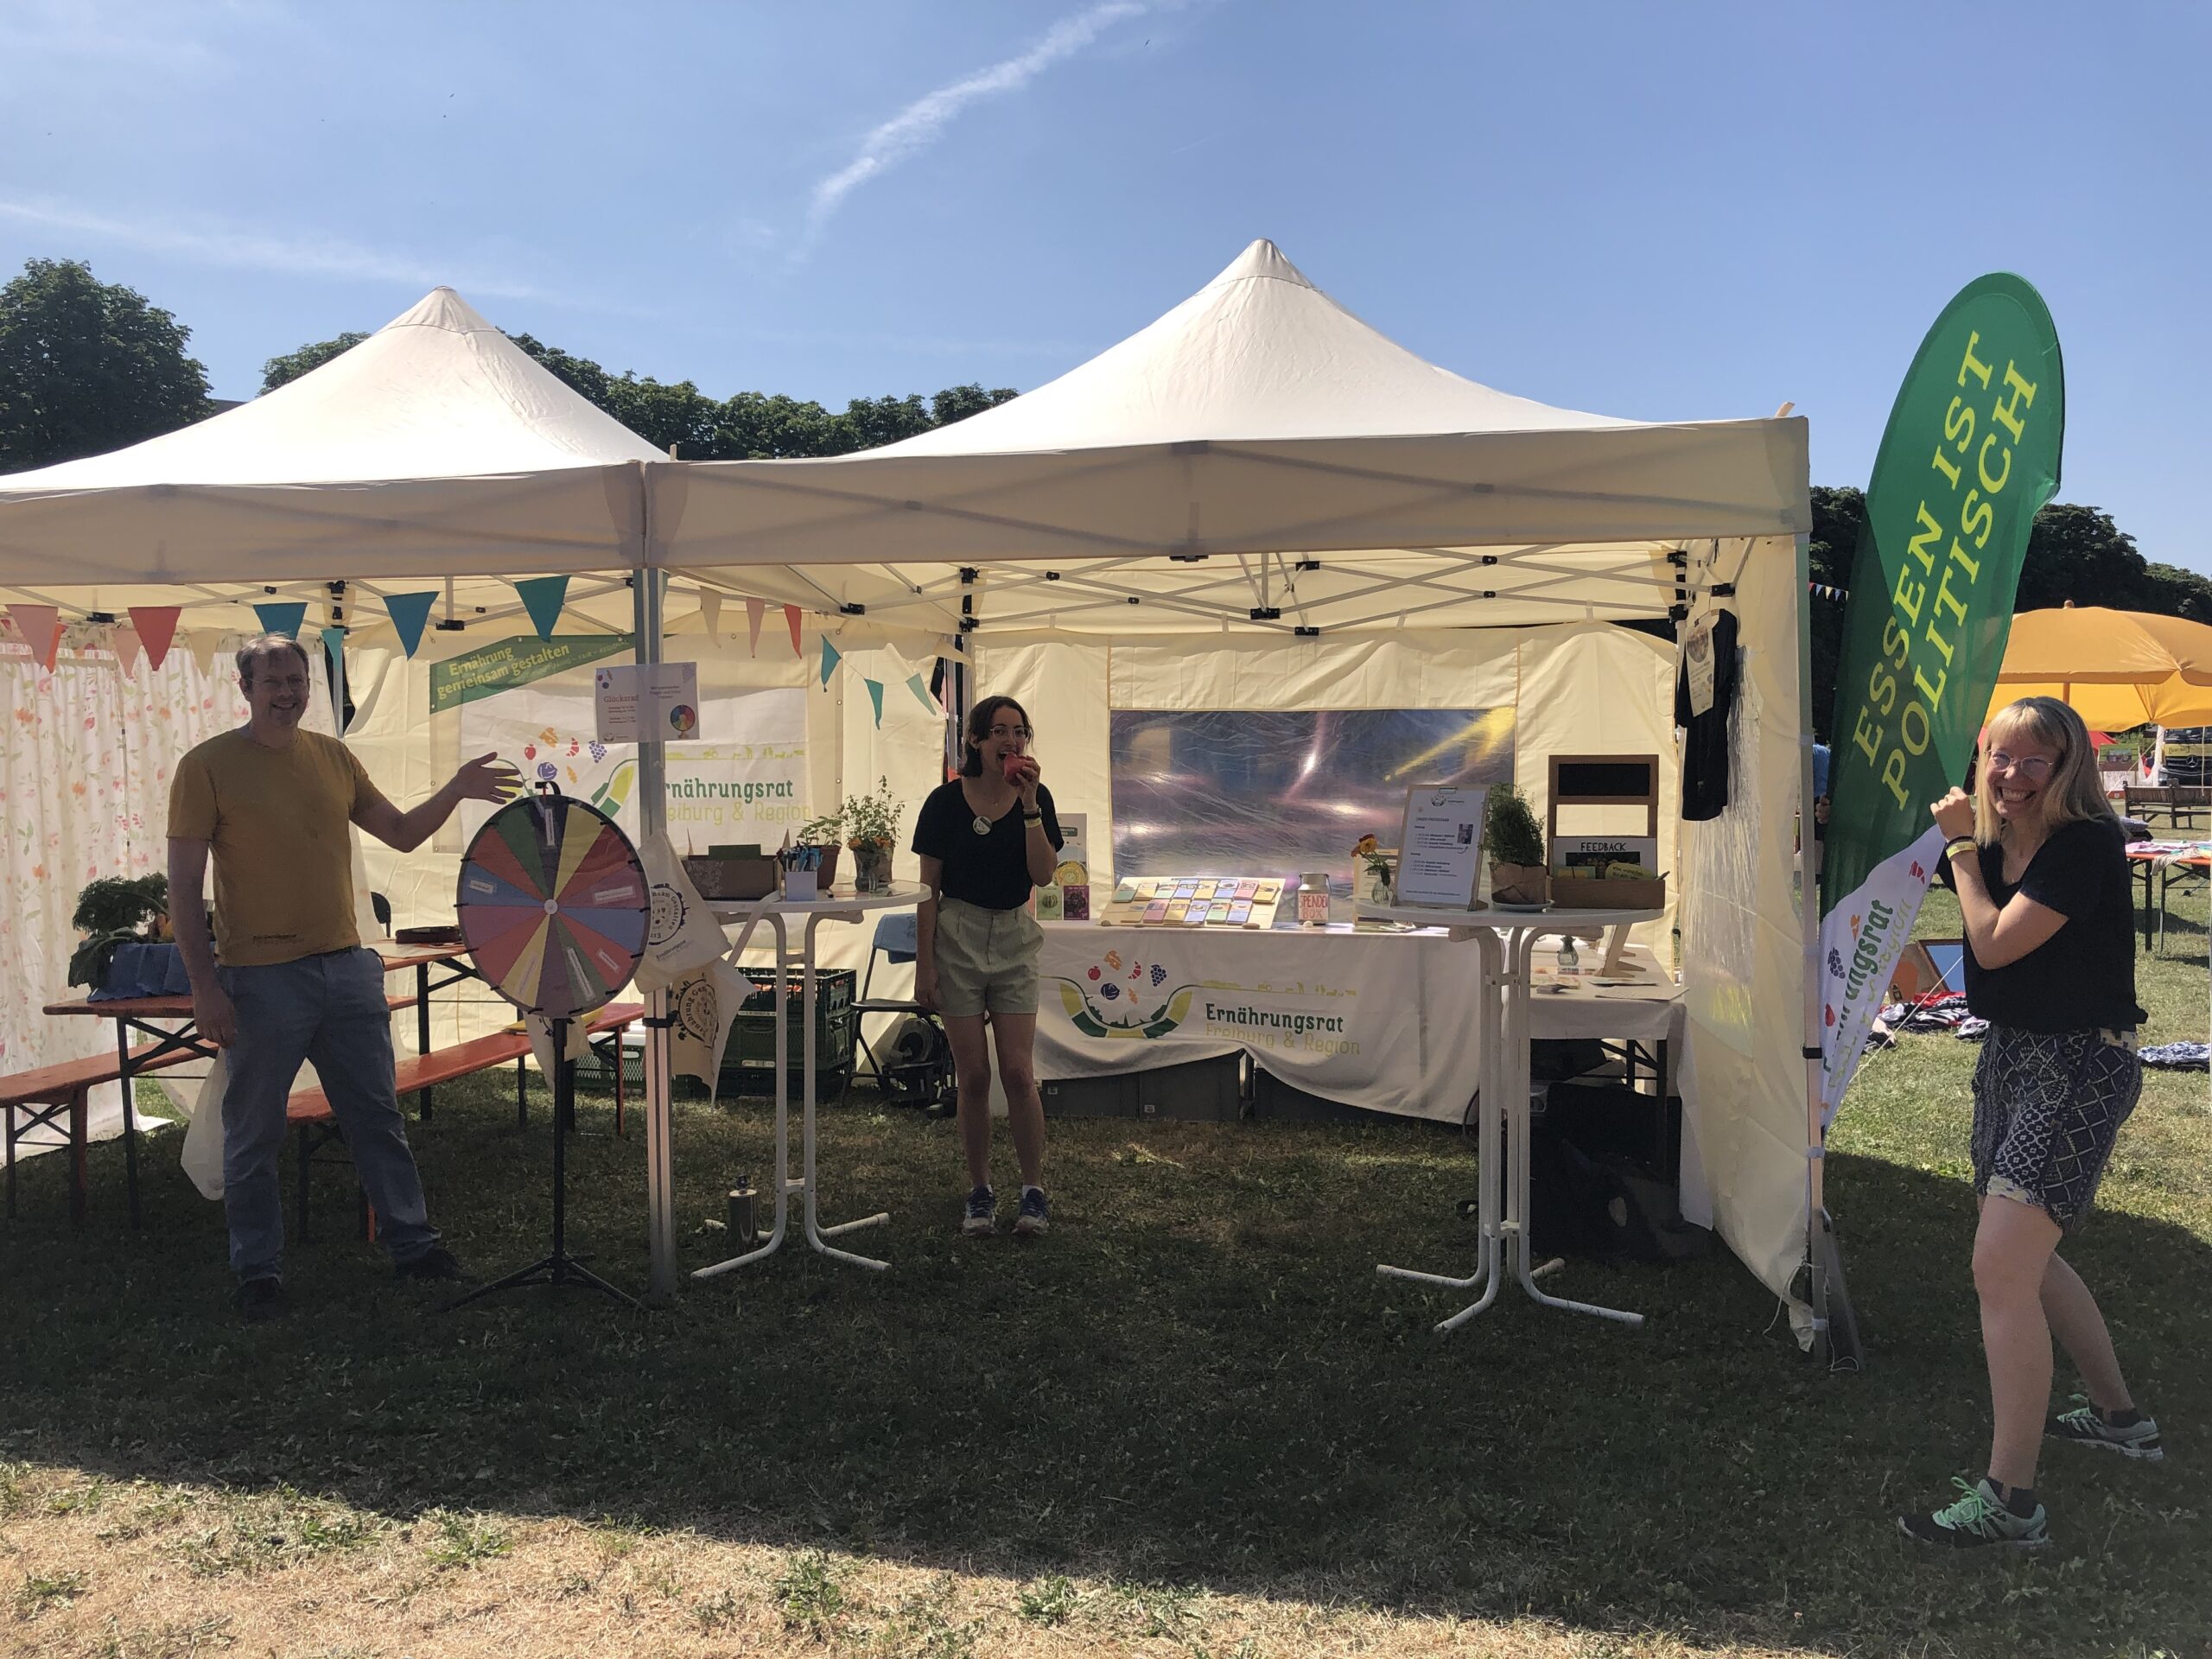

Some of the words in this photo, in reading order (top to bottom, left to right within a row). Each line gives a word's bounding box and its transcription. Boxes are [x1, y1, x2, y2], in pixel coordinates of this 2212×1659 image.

[1853, 500, 1942, 767] ESSEN
[1932, 330, 1993, 491] IST
[1881, 359, 2037, 810] POLITISCH
[436, 666, 509, 700] gemeinsam
[512, 644, 570, 677] gestalten
[448, 646, 512, 676] Ernährung
[664, 777, 793, 804] rnährungsrat
[667, 802, 723, 826] eiburg
[732, 801, 744, 822] &
[1580, 842, 1627, 852] FEEDBACK
[1302, 907, 1324, 919] BOX
[1205, 1003, 1344, 1035] Ernährungsrat
[1282, 1031, 1295, 1049] &
[1304, 1032, 1361, 1058] Region
